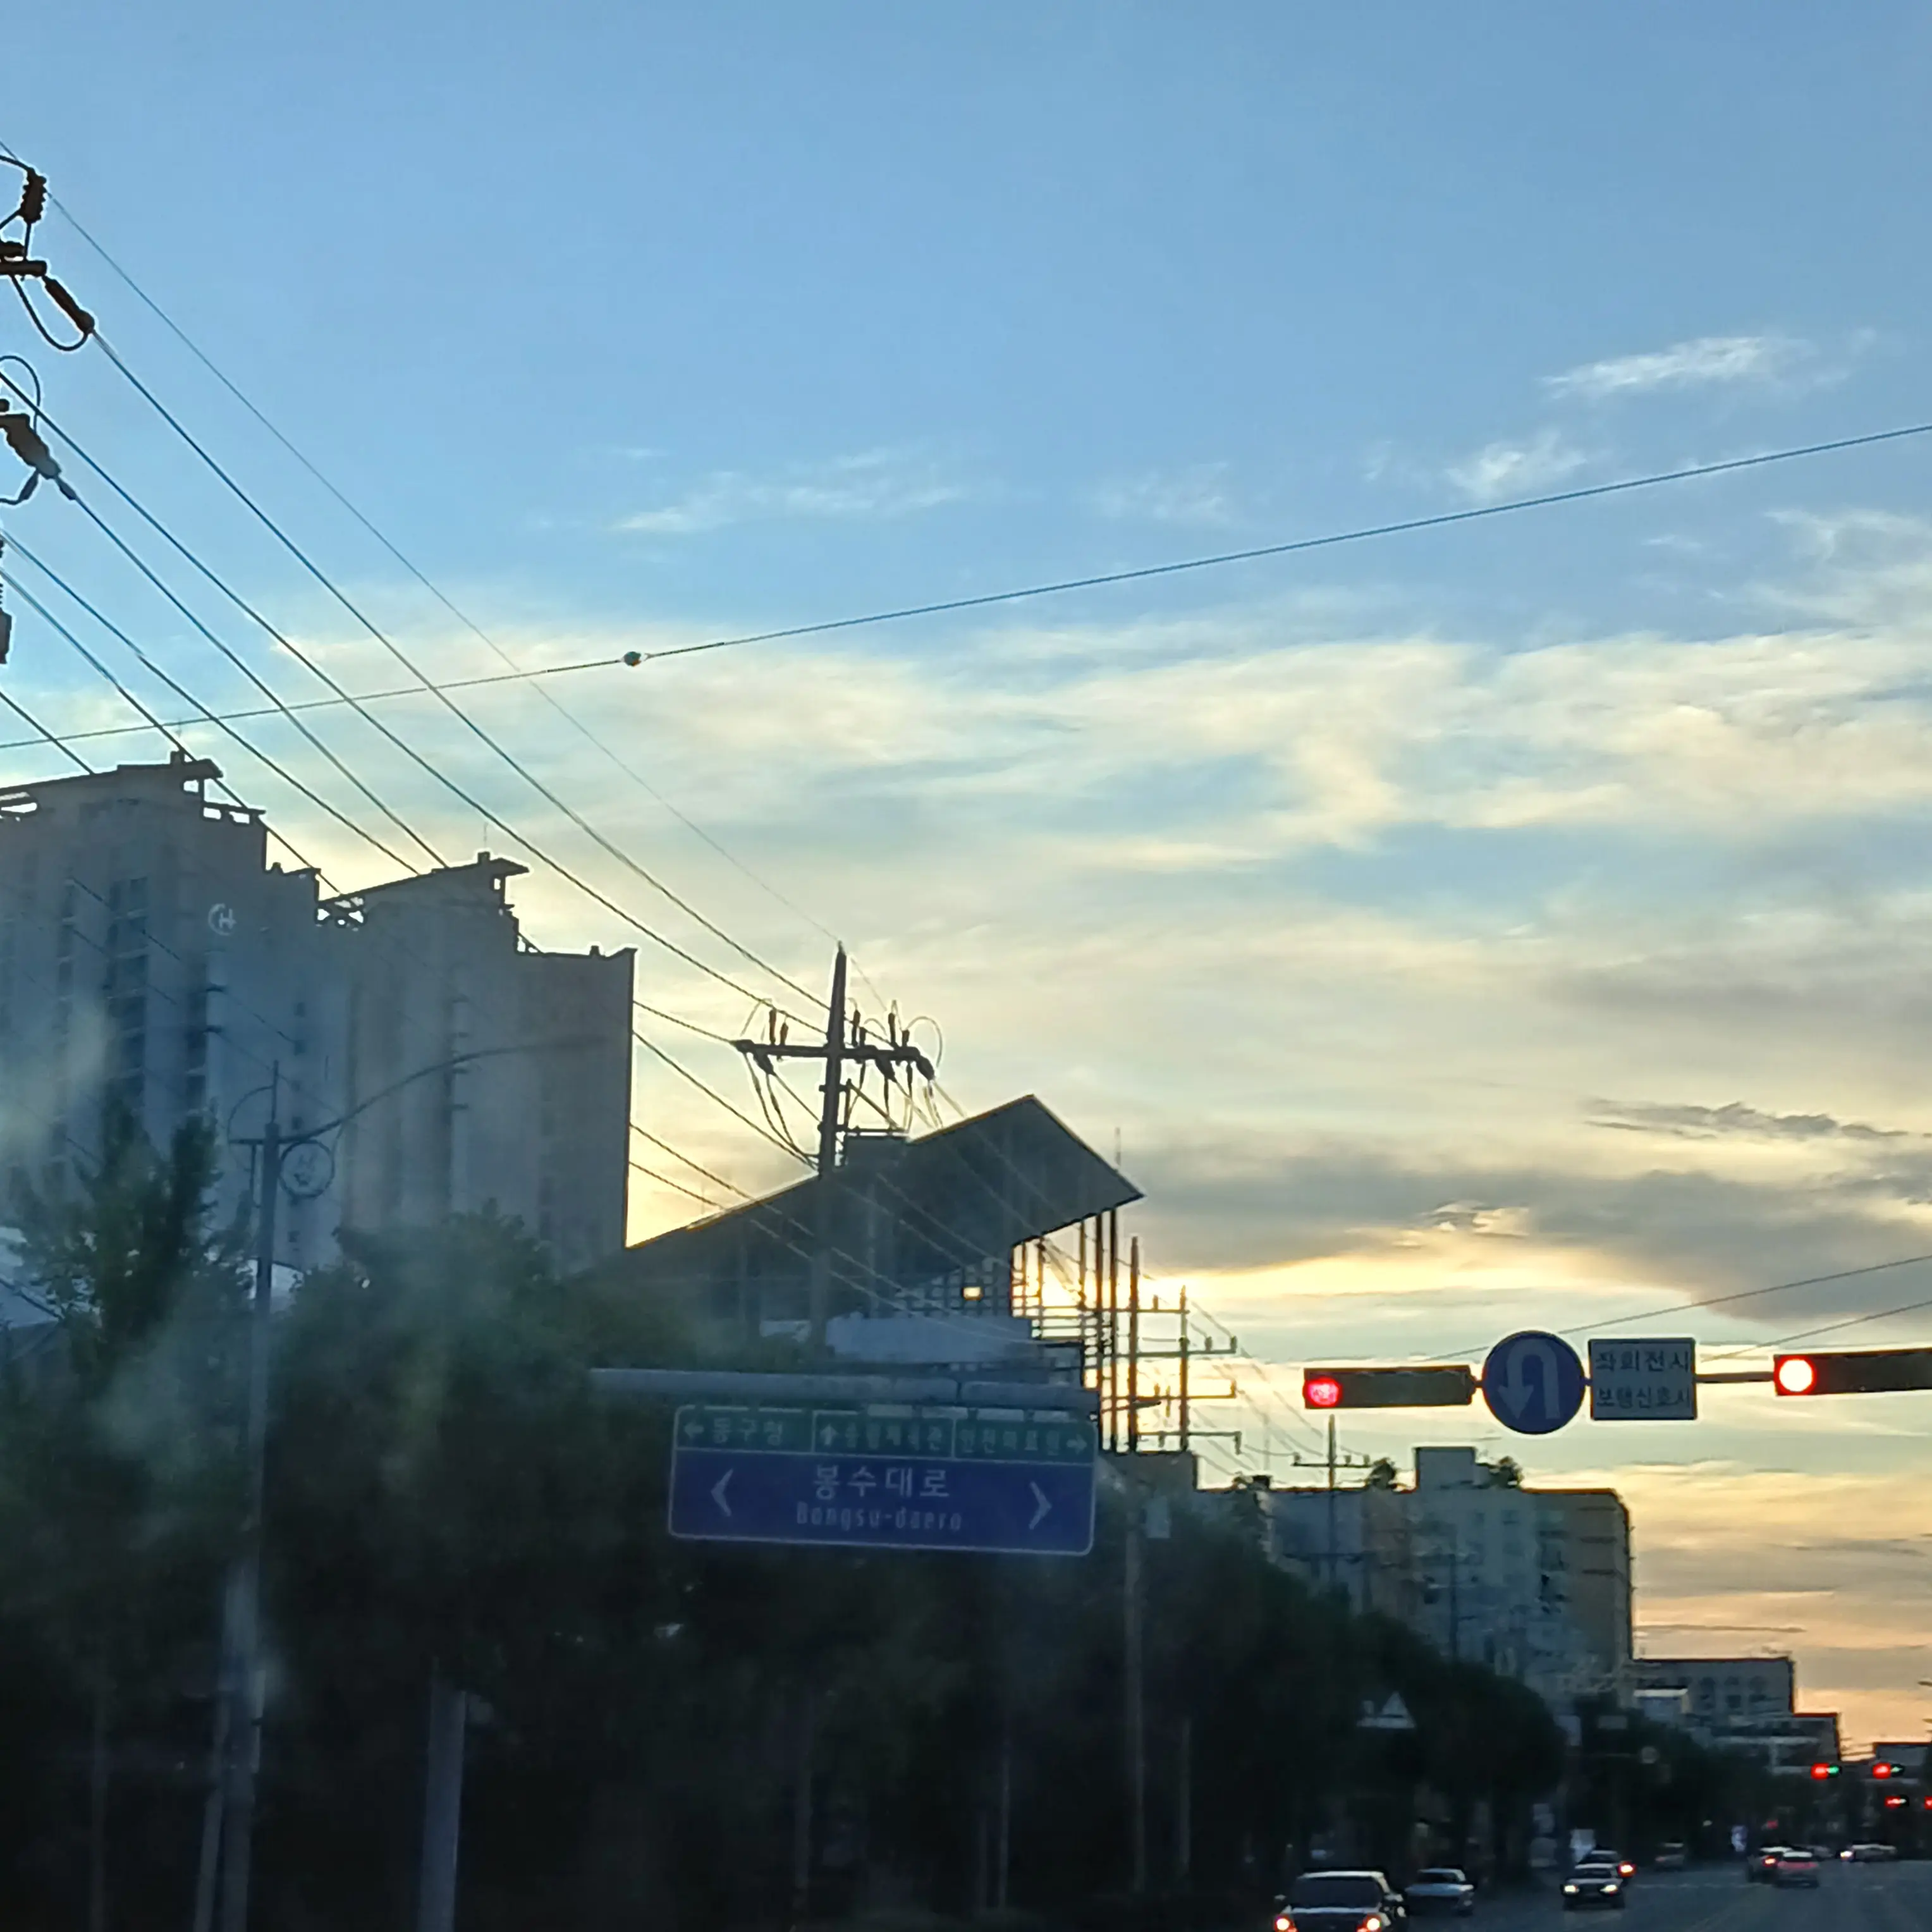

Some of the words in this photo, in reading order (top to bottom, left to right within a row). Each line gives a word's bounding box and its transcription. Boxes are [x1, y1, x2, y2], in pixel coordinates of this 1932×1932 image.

[1595, 1350, 1689, 1373] 좌회전시
[813, 1465, 950, 1500] 봉수대로
[797, 1501, 962, 1532] Bongsu-daero
